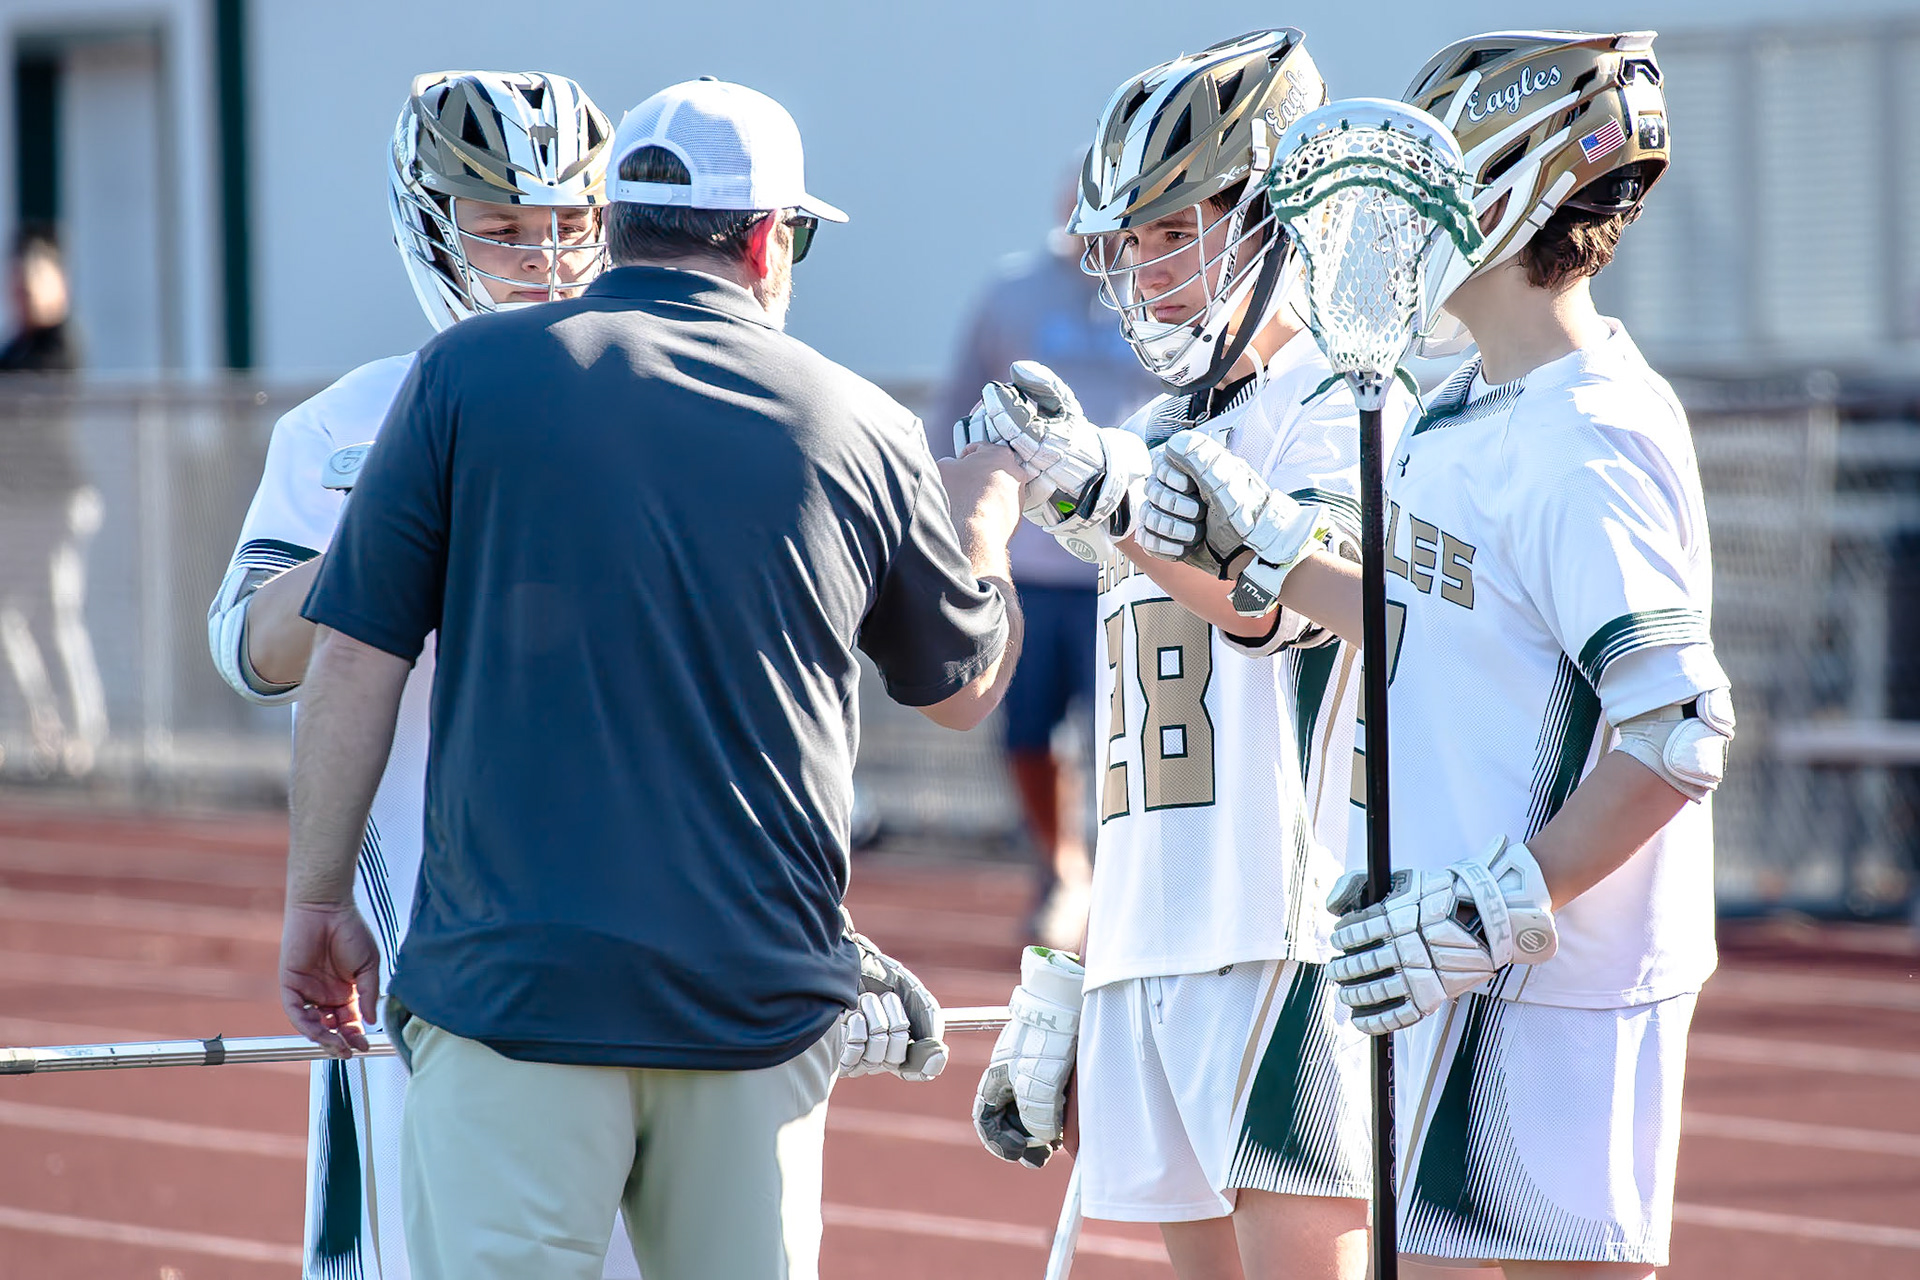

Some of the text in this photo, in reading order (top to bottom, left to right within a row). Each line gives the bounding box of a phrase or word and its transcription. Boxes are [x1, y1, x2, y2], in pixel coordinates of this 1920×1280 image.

[1264, 69, 1307, 138] Eagl
[1466, 65, 1562, 123] Eagles
[1386, 499, 1477, 611] LES
